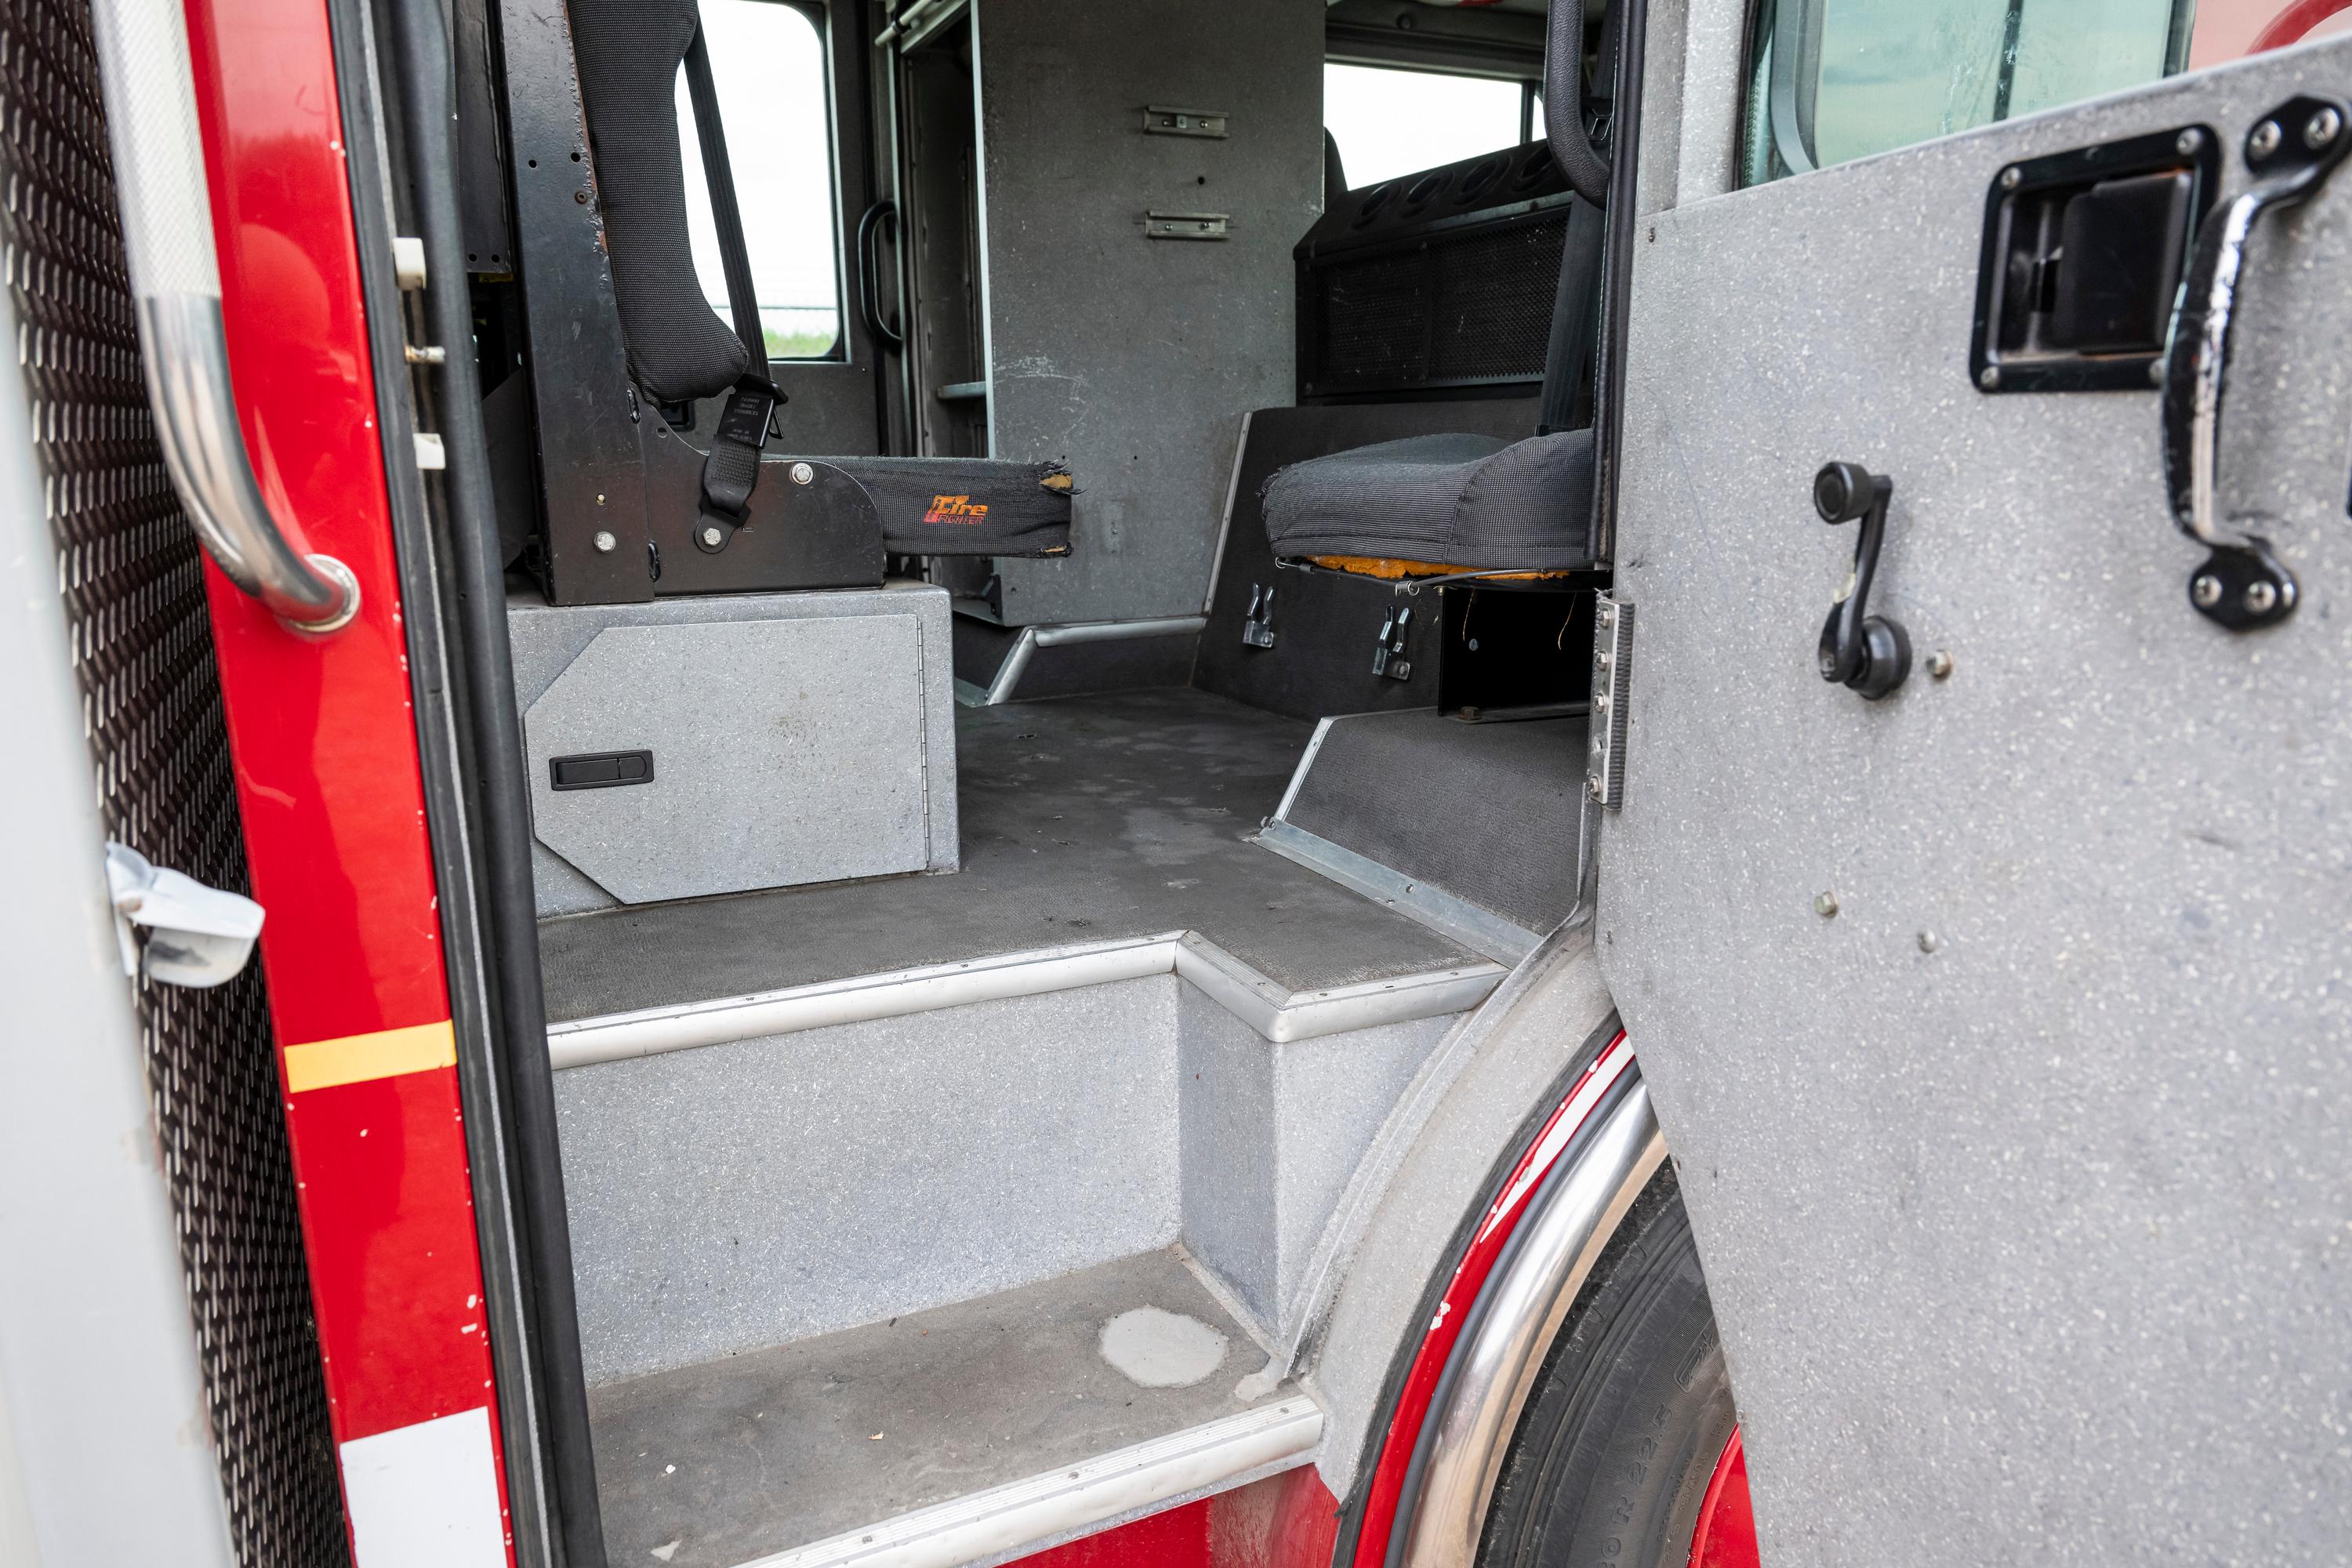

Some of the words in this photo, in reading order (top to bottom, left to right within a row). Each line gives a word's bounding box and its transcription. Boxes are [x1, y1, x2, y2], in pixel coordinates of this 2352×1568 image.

[924, 495, 989, 523] Fire
[1611, 1496, 1635, 1525] R
[1628, 1403, 1673, 1486] 22.5
